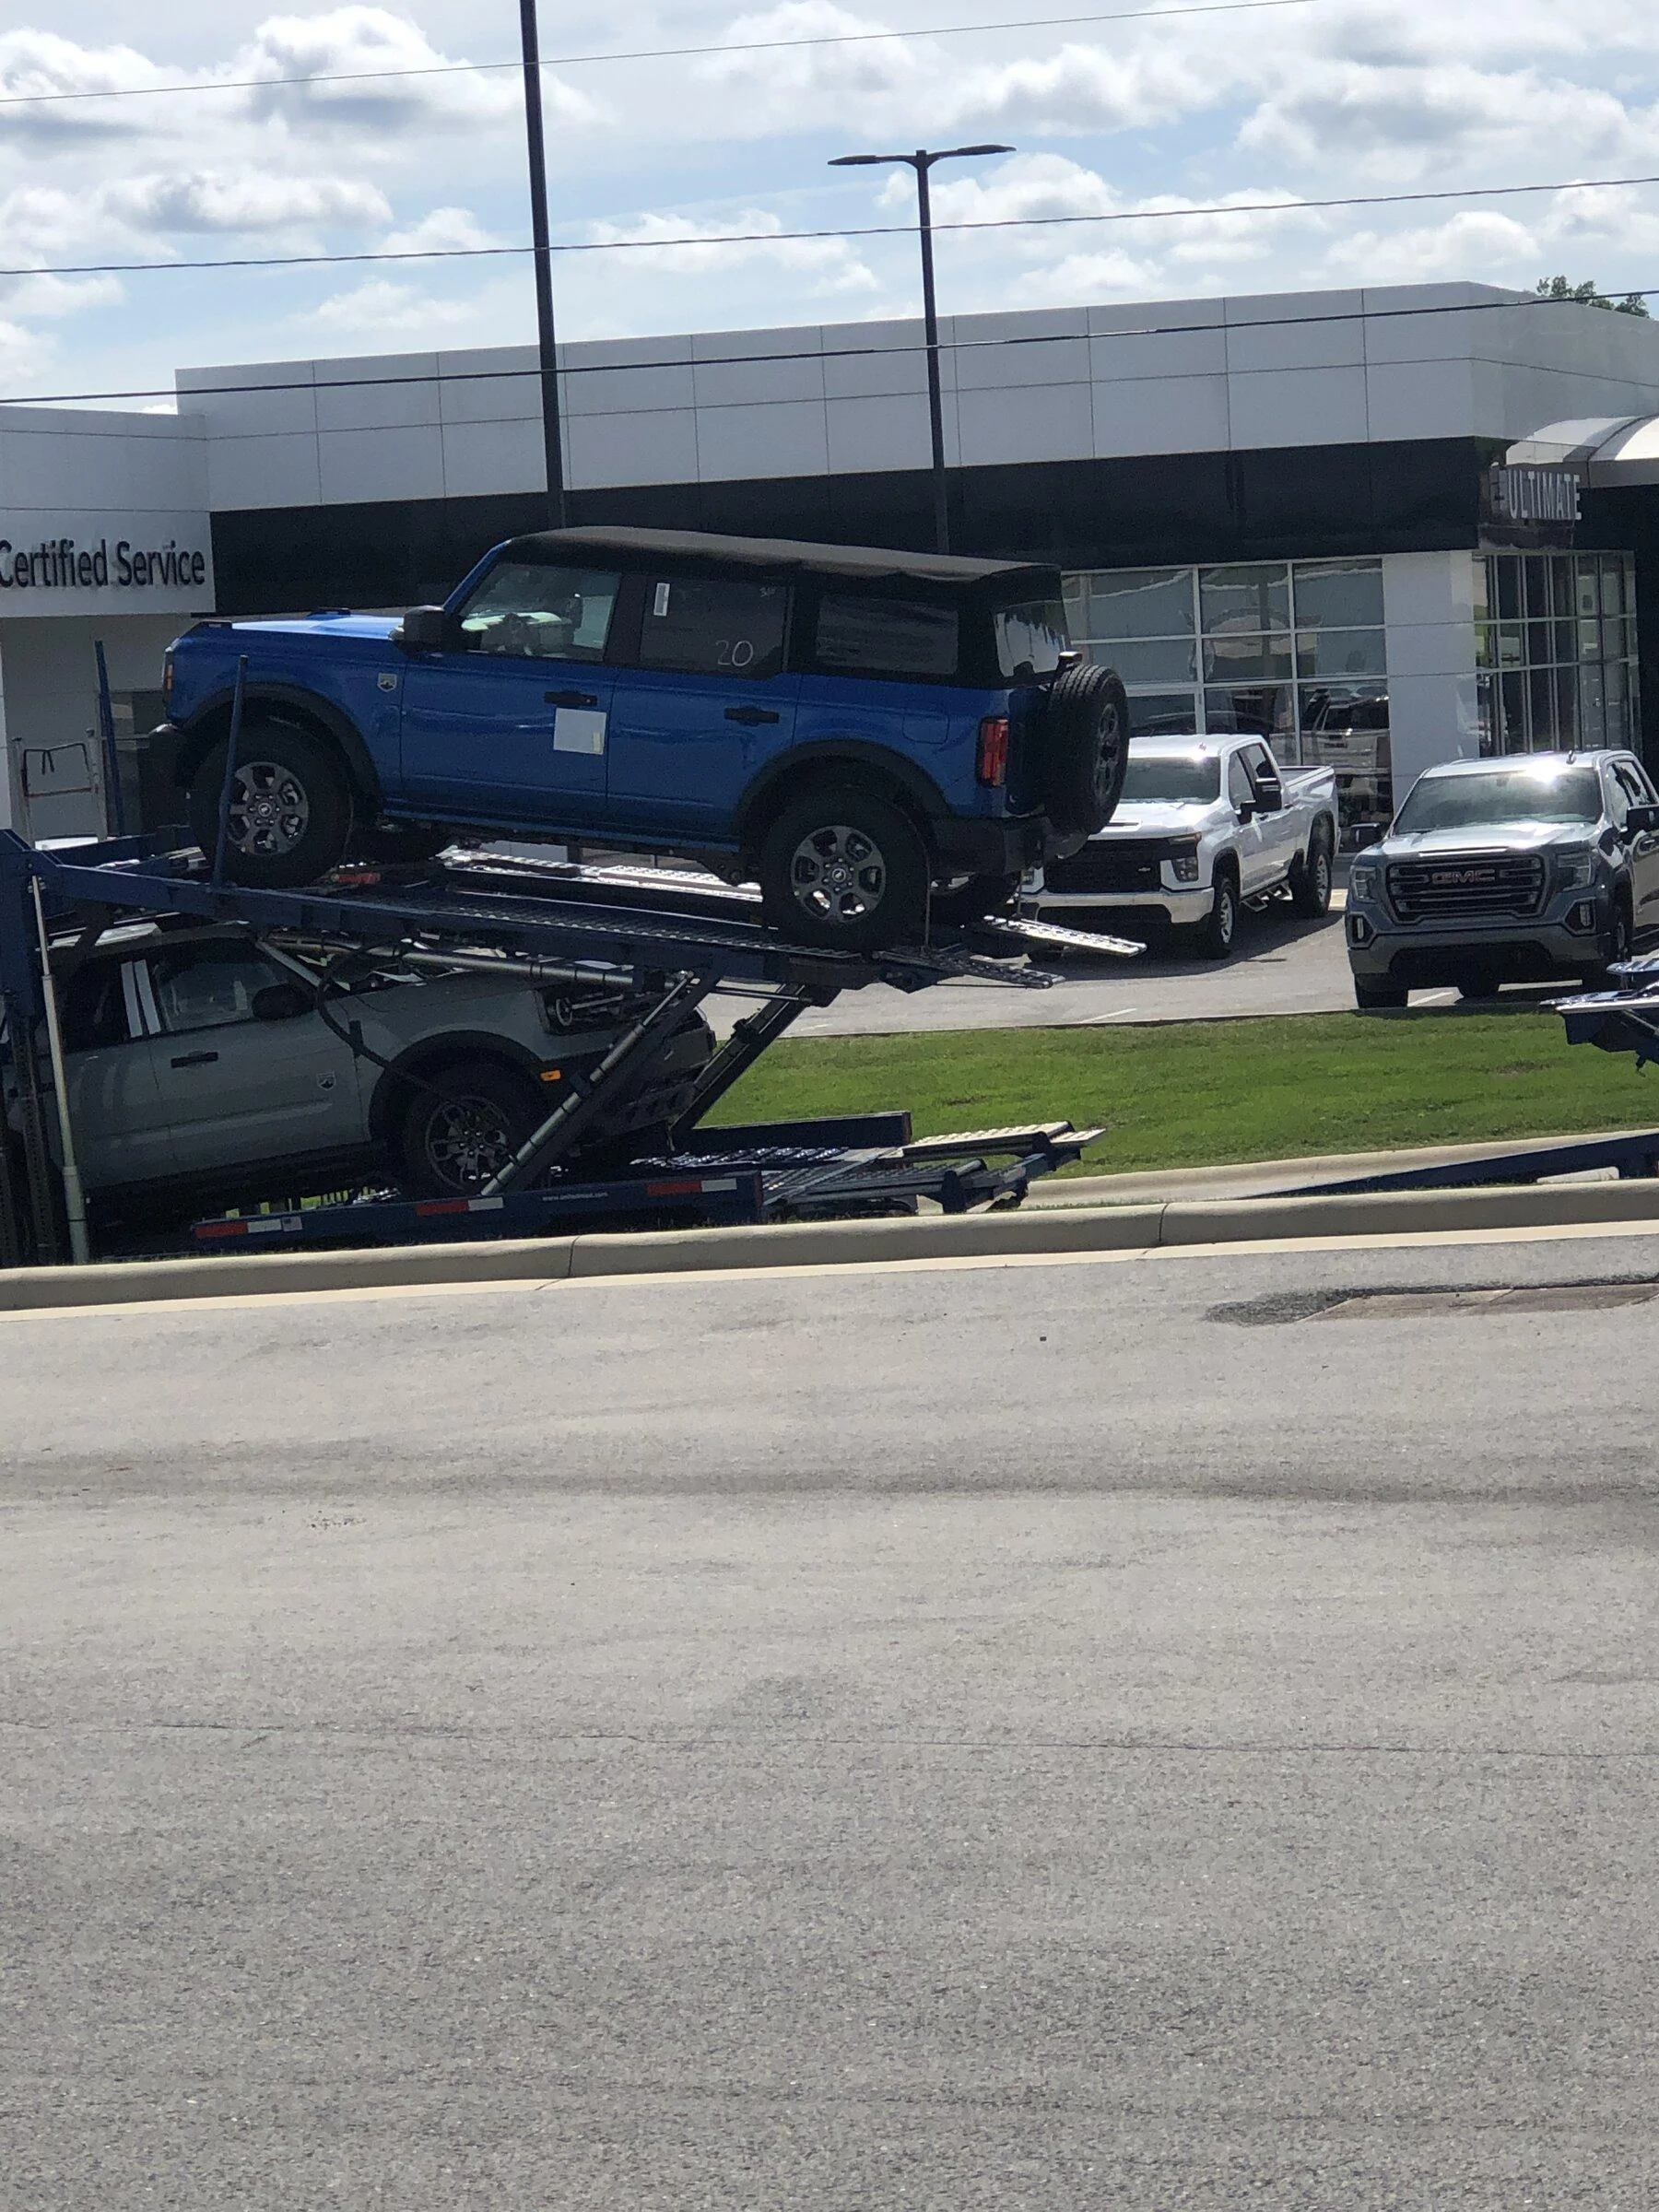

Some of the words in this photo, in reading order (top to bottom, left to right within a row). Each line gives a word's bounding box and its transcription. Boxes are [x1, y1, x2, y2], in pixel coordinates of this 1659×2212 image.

[1507, 468, 1583, 521] ULTIMATE
[0, 537, 109, 587] Certified
[116, 539, 206, 586] Service
[713, 640, 754, 666] 20
[1431, 868, 1496, 885] GMC
